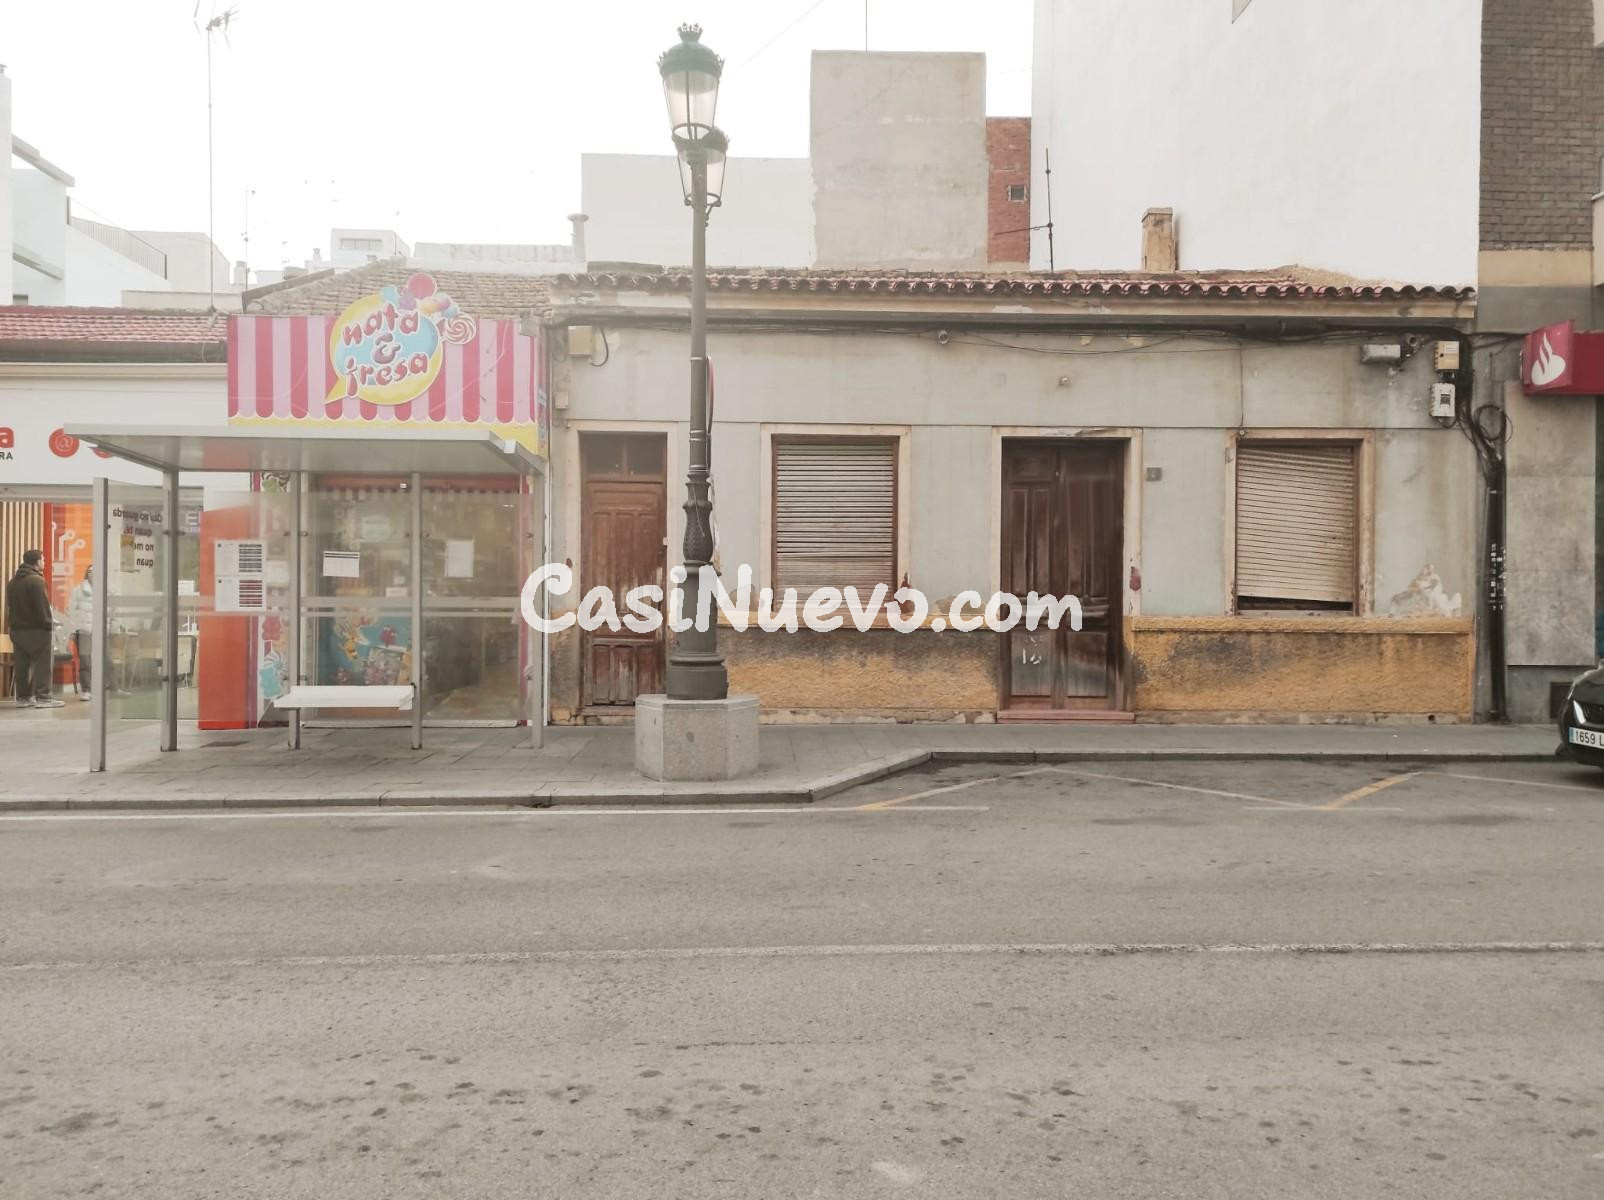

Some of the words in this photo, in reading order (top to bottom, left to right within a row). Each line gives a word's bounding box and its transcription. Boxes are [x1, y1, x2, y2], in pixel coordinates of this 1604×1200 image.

[342, 302, 419, 346] nata
[344, 352, 429, 398] fresa
[1575, 731, 1596, 744] 1659
